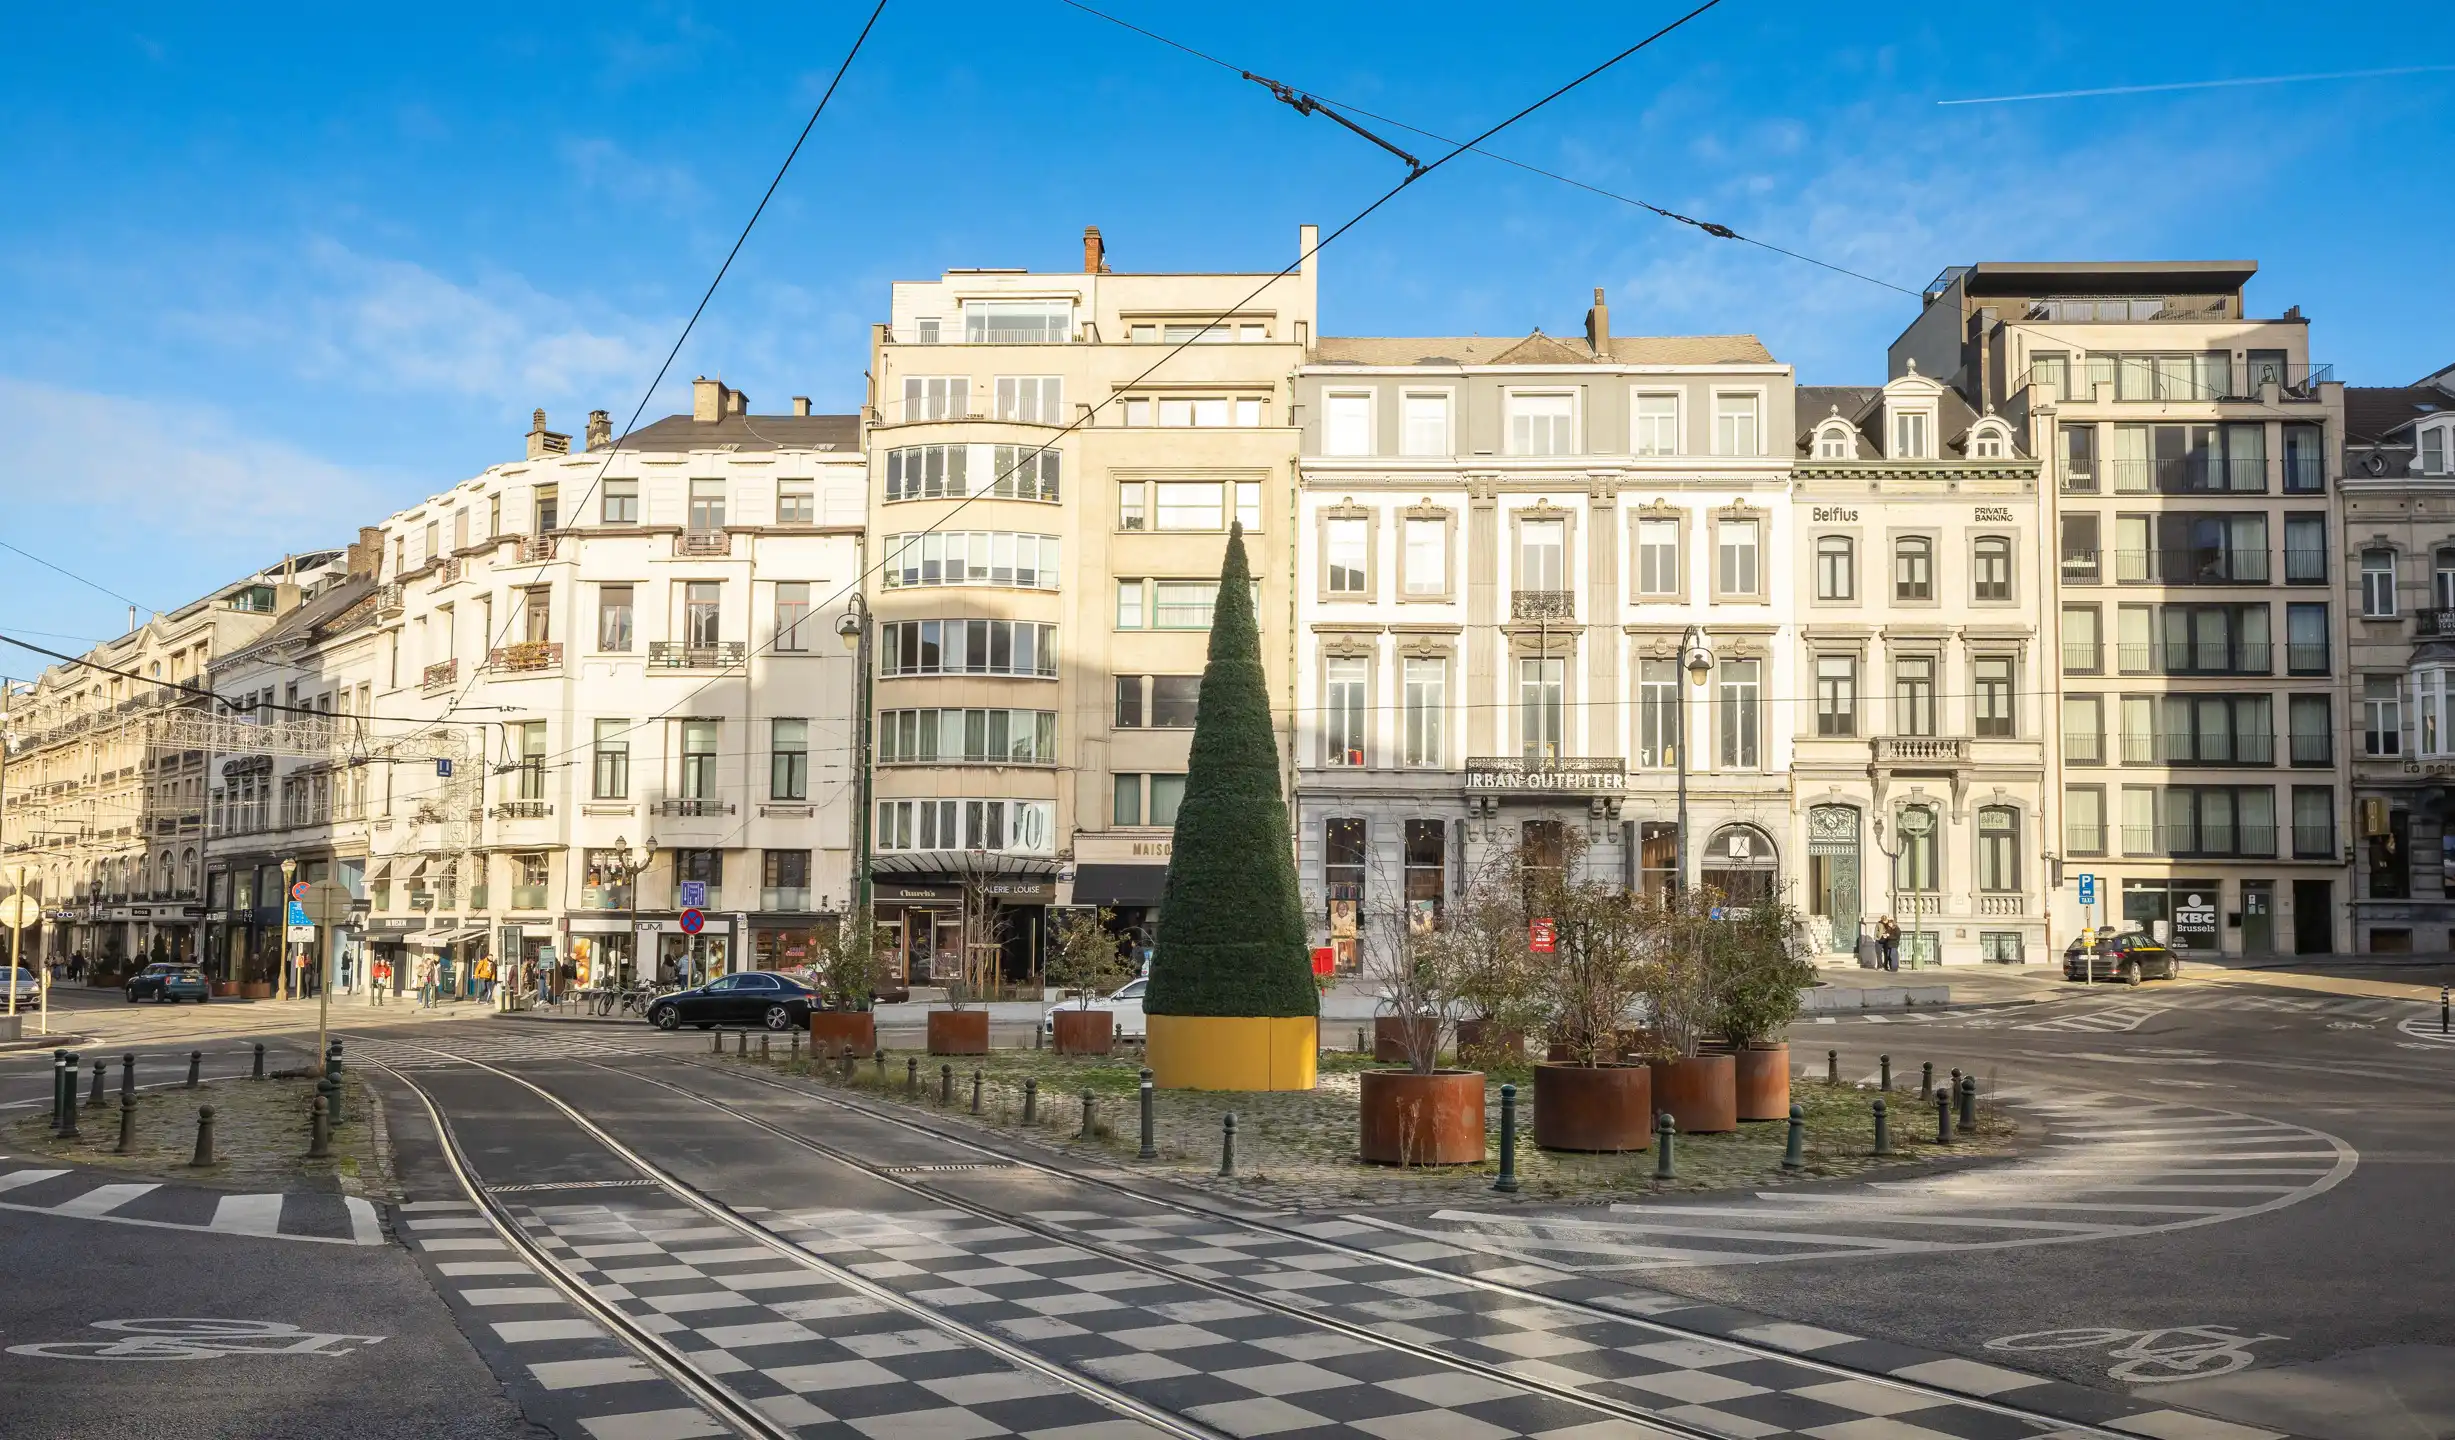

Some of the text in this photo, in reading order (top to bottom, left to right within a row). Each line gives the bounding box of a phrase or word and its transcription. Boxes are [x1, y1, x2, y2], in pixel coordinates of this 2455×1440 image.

[1812, 507, 1859, 522] Belfius
[1974, 507, 2009, 515] PRIVATE
[1974, 514, 2014, 522] BANKING
[1464, 773, 1631, 789] URBAN OUTFITTERS
[899, 889, 936, 898] Church's
[1013, 885, 1041, 894] LOUISE
[2176, 912, 2215, 924] KBC
[2176, 924, 2216, 932] Brussels
